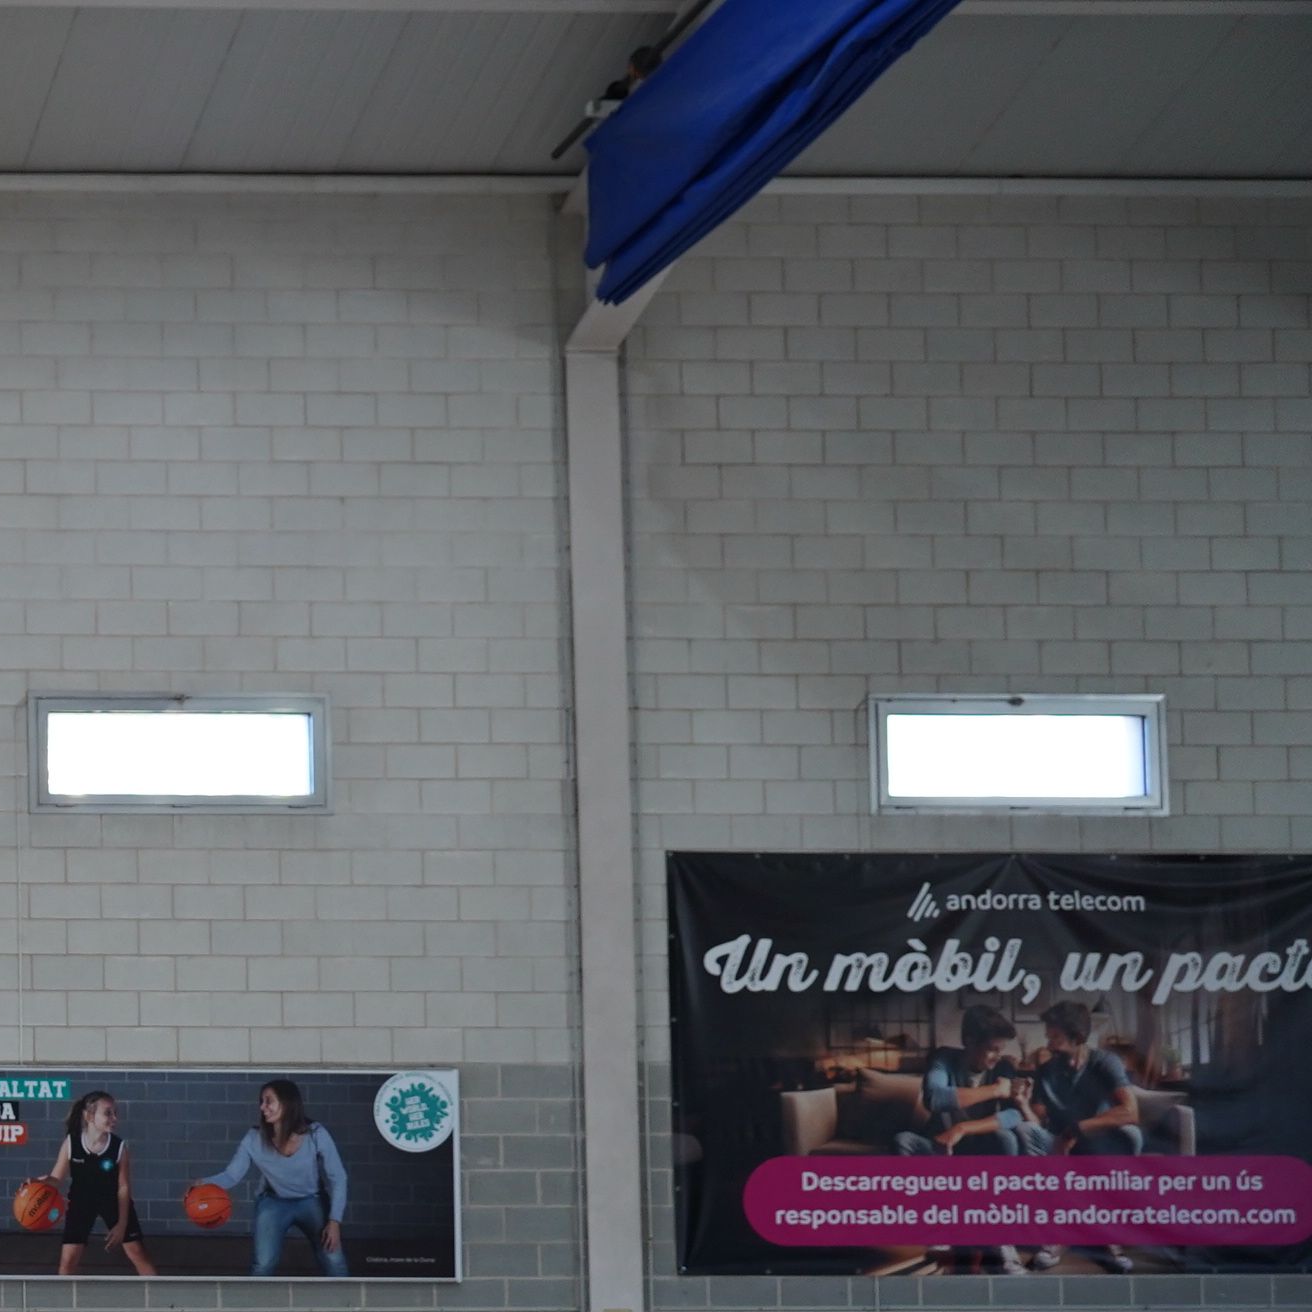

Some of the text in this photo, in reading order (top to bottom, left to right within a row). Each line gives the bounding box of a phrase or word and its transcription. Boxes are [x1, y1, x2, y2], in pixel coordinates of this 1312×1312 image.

[945, 889, 1146, 912] andorra telecom
[703, 934, 1312, 1006] Un mòbil, un pact
[801, 1169, 1264, 1197] Descarregueu el pacte familiar per un ús
[775, 1203, 1296, 1230] responsable del mòbil a andorratelecom.com
